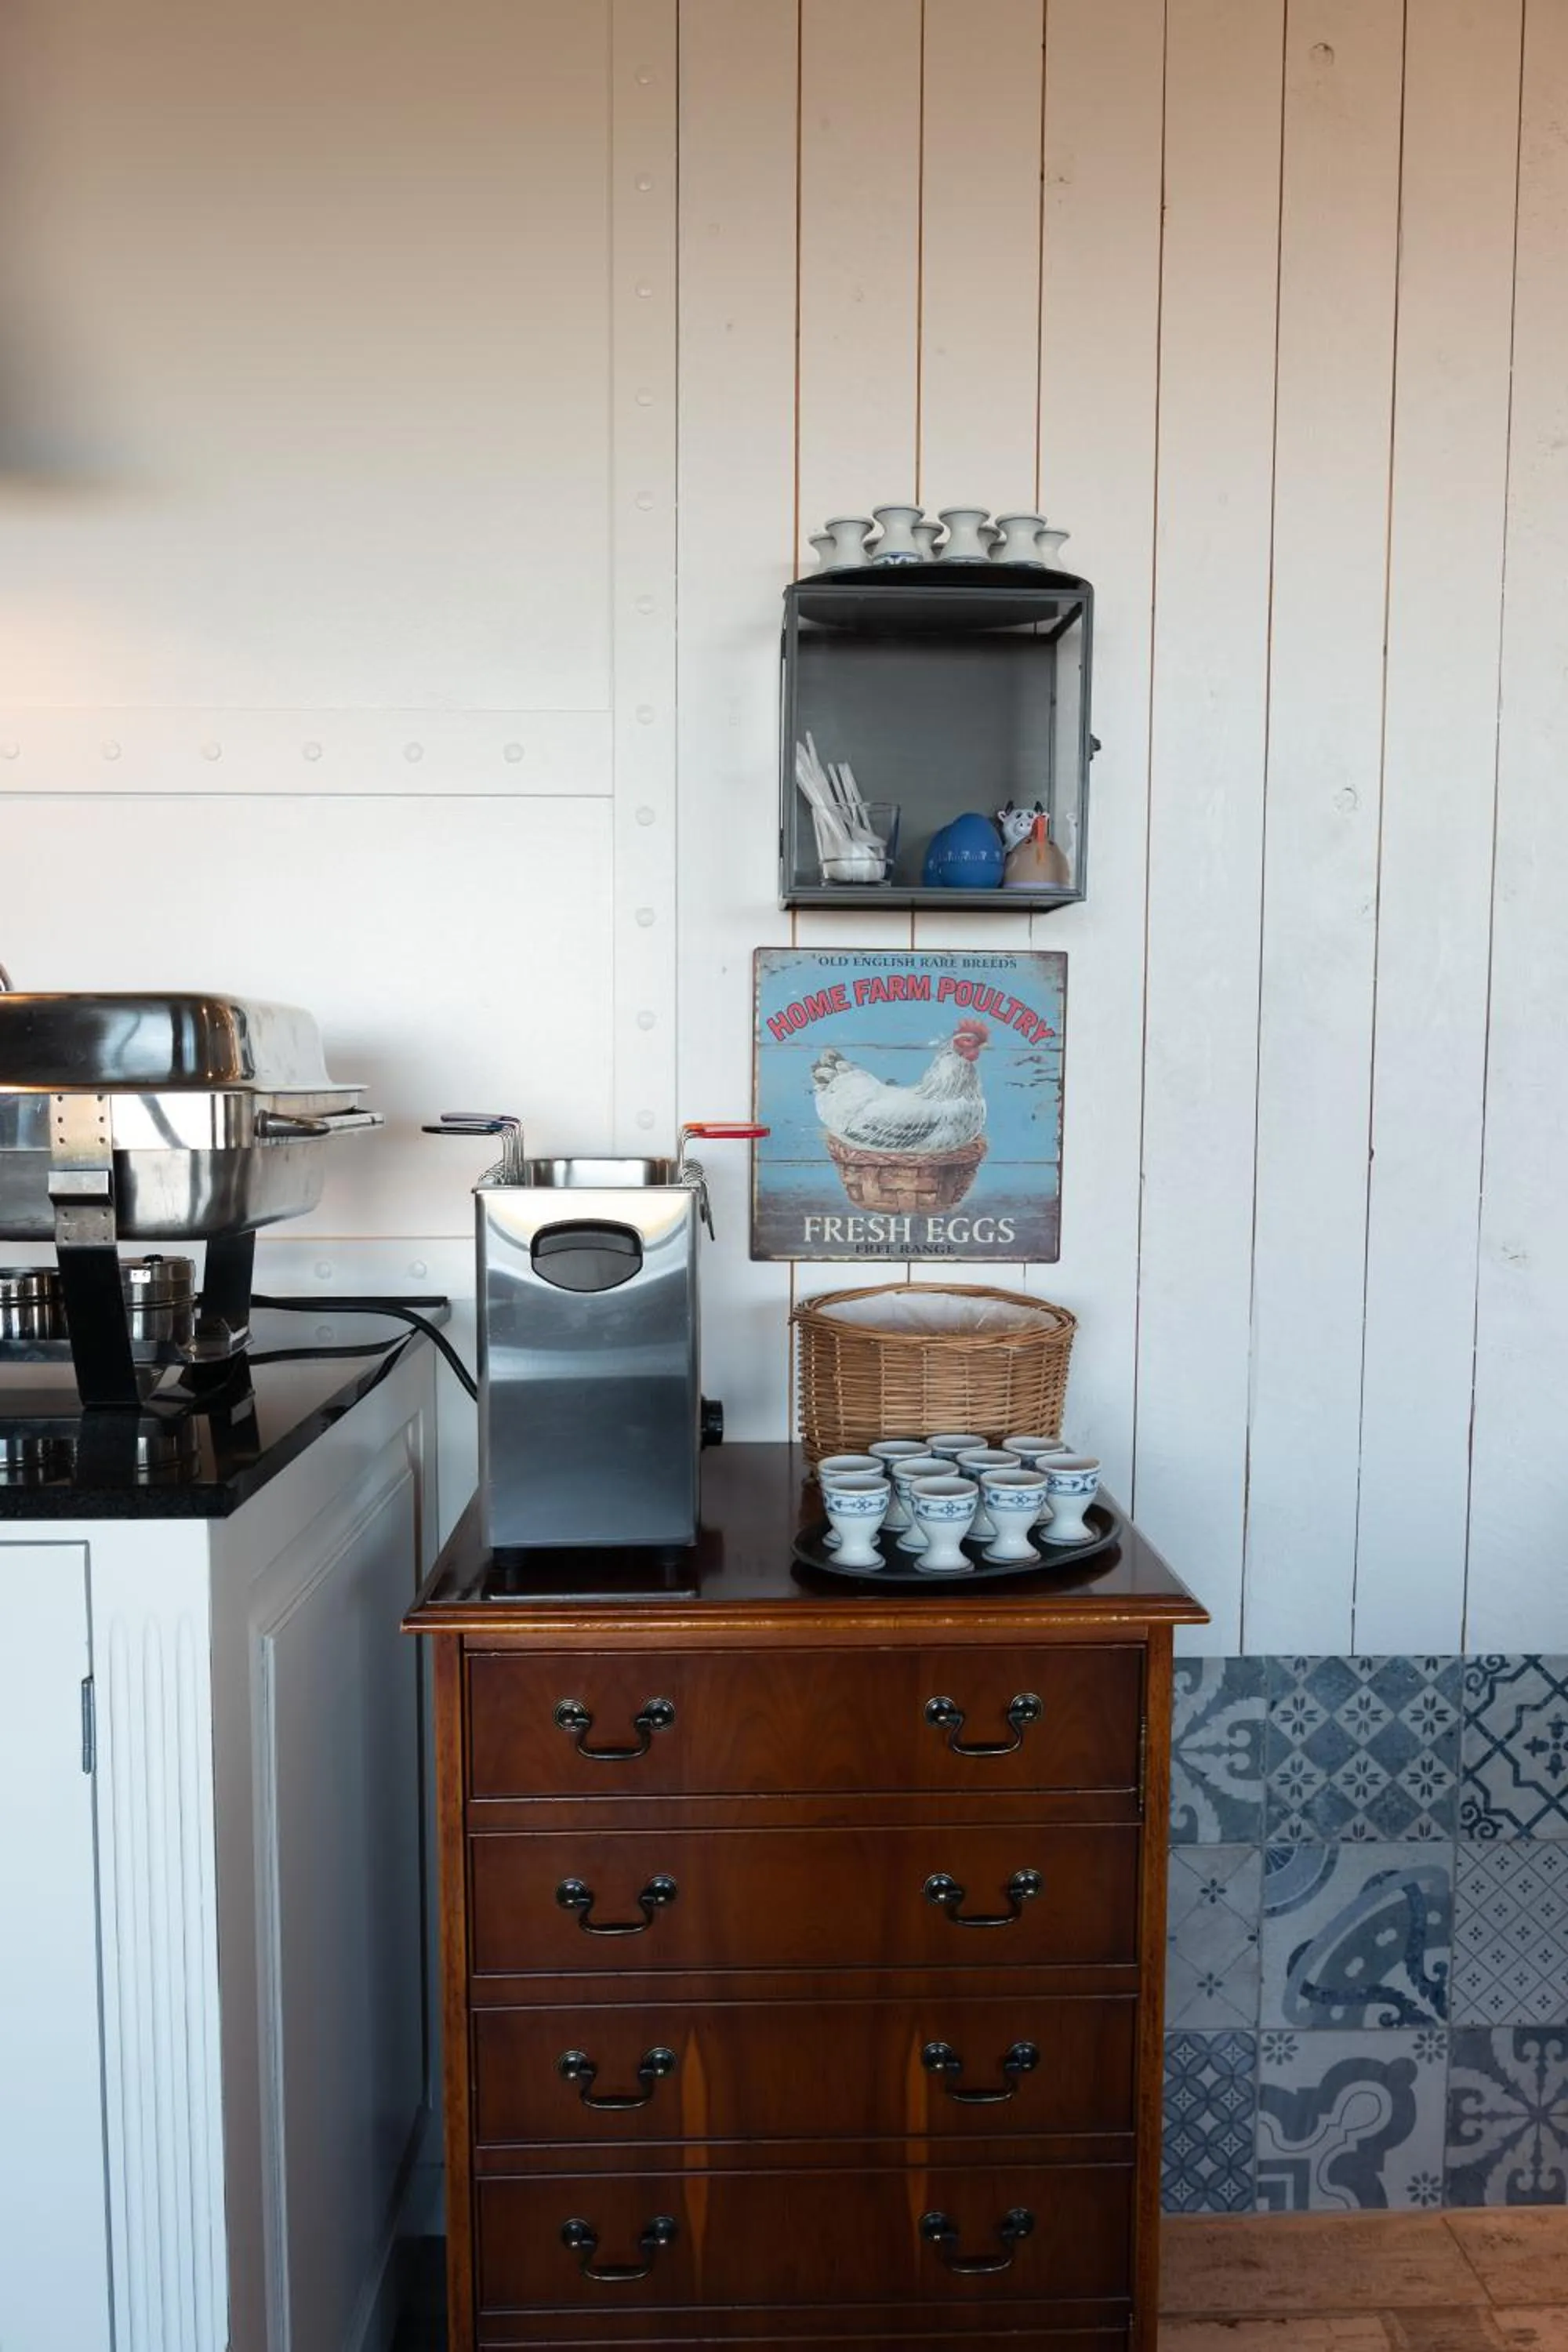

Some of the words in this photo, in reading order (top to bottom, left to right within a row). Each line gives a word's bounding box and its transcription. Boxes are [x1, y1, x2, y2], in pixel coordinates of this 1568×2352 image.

[818, 956, 849, 967] OLD
[853, 956, 915, 967] ENGLISH
[920, 957, 957, 968] RARE
[962, 958, 1017, 969] BREEDS
[766, 982, 852, 1041] HOME
[852, 975, 931, 1007] FARM
[937, 976, 1056, 1045] POULTRY
[803, 1216, 911, 1243] FRESH
[926, 1218, 1016, 1243] EGGS
[855, 1244, 894, 1254] FREE
[899, 1244, 956, 1254] RANGE
